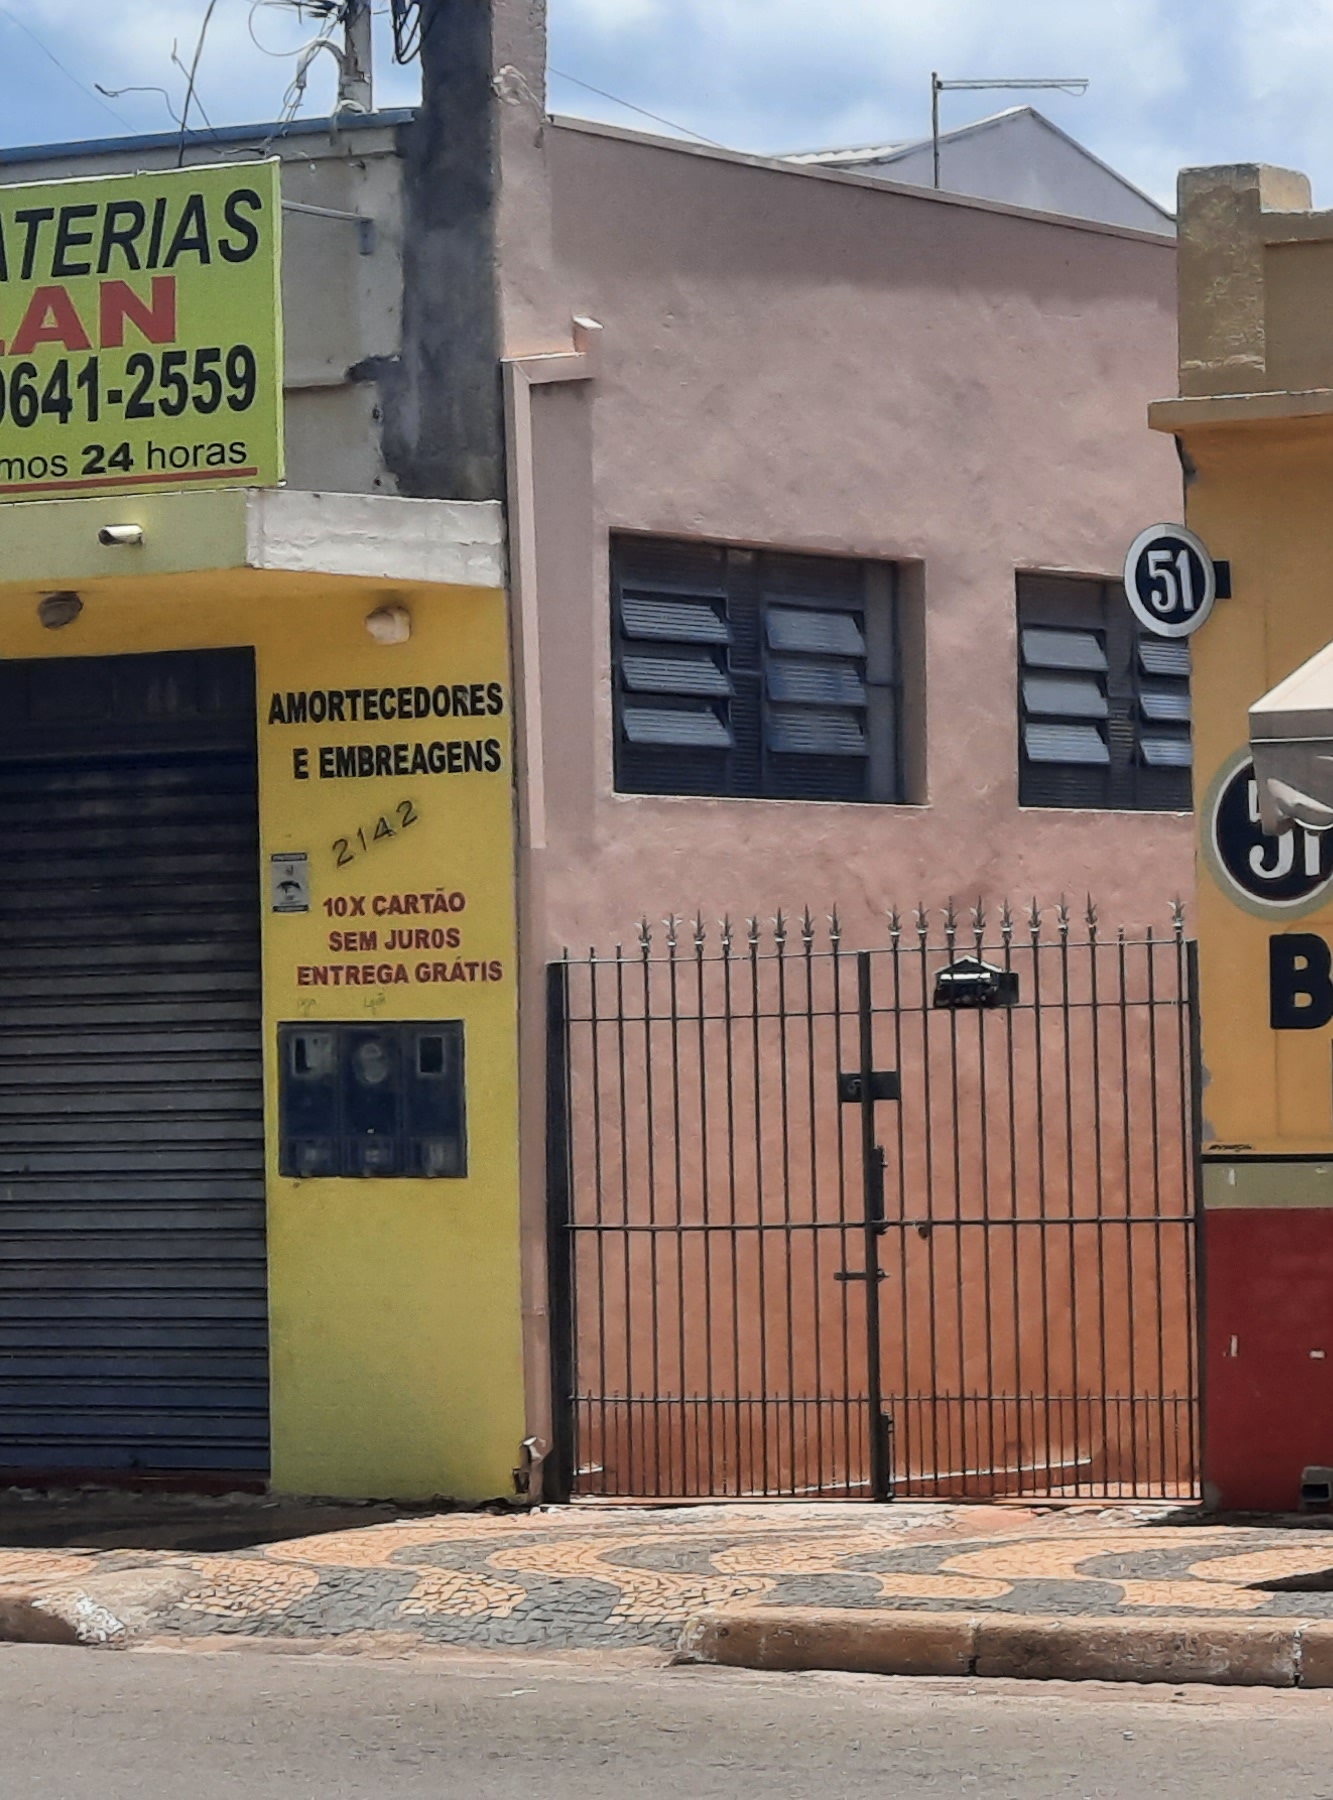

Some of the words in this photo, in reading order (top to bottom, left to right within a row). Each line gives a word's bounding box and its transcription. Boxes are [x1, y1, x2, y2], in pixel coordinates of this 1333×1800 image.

[0, 188, 263, 283] TERIAS
[0, 275, 177, 357] AN
[0, 344, 257, 428] 641-2559
[81, 442, 134, 476] 24
[147, 440, 248, 470] horas
[1146, 548, 1196, 614] 51
[267, 681, 505, 726] AMORTECEDORES
[292, 747, 310, 781] E
[318, 737, 502, 780] EMBREAGENS
[332, 799, 420, 868] 2142
[322, 895, 366, 918] 10X
[371, 887, 467, 917] CARTÃO
[328, 929, 378, 953] SEM
[384, 926, 462, 951] JUROS
[296, 962, 410, 987] ENTREGA
[414, 956, 504, 984] GRÁTIS
